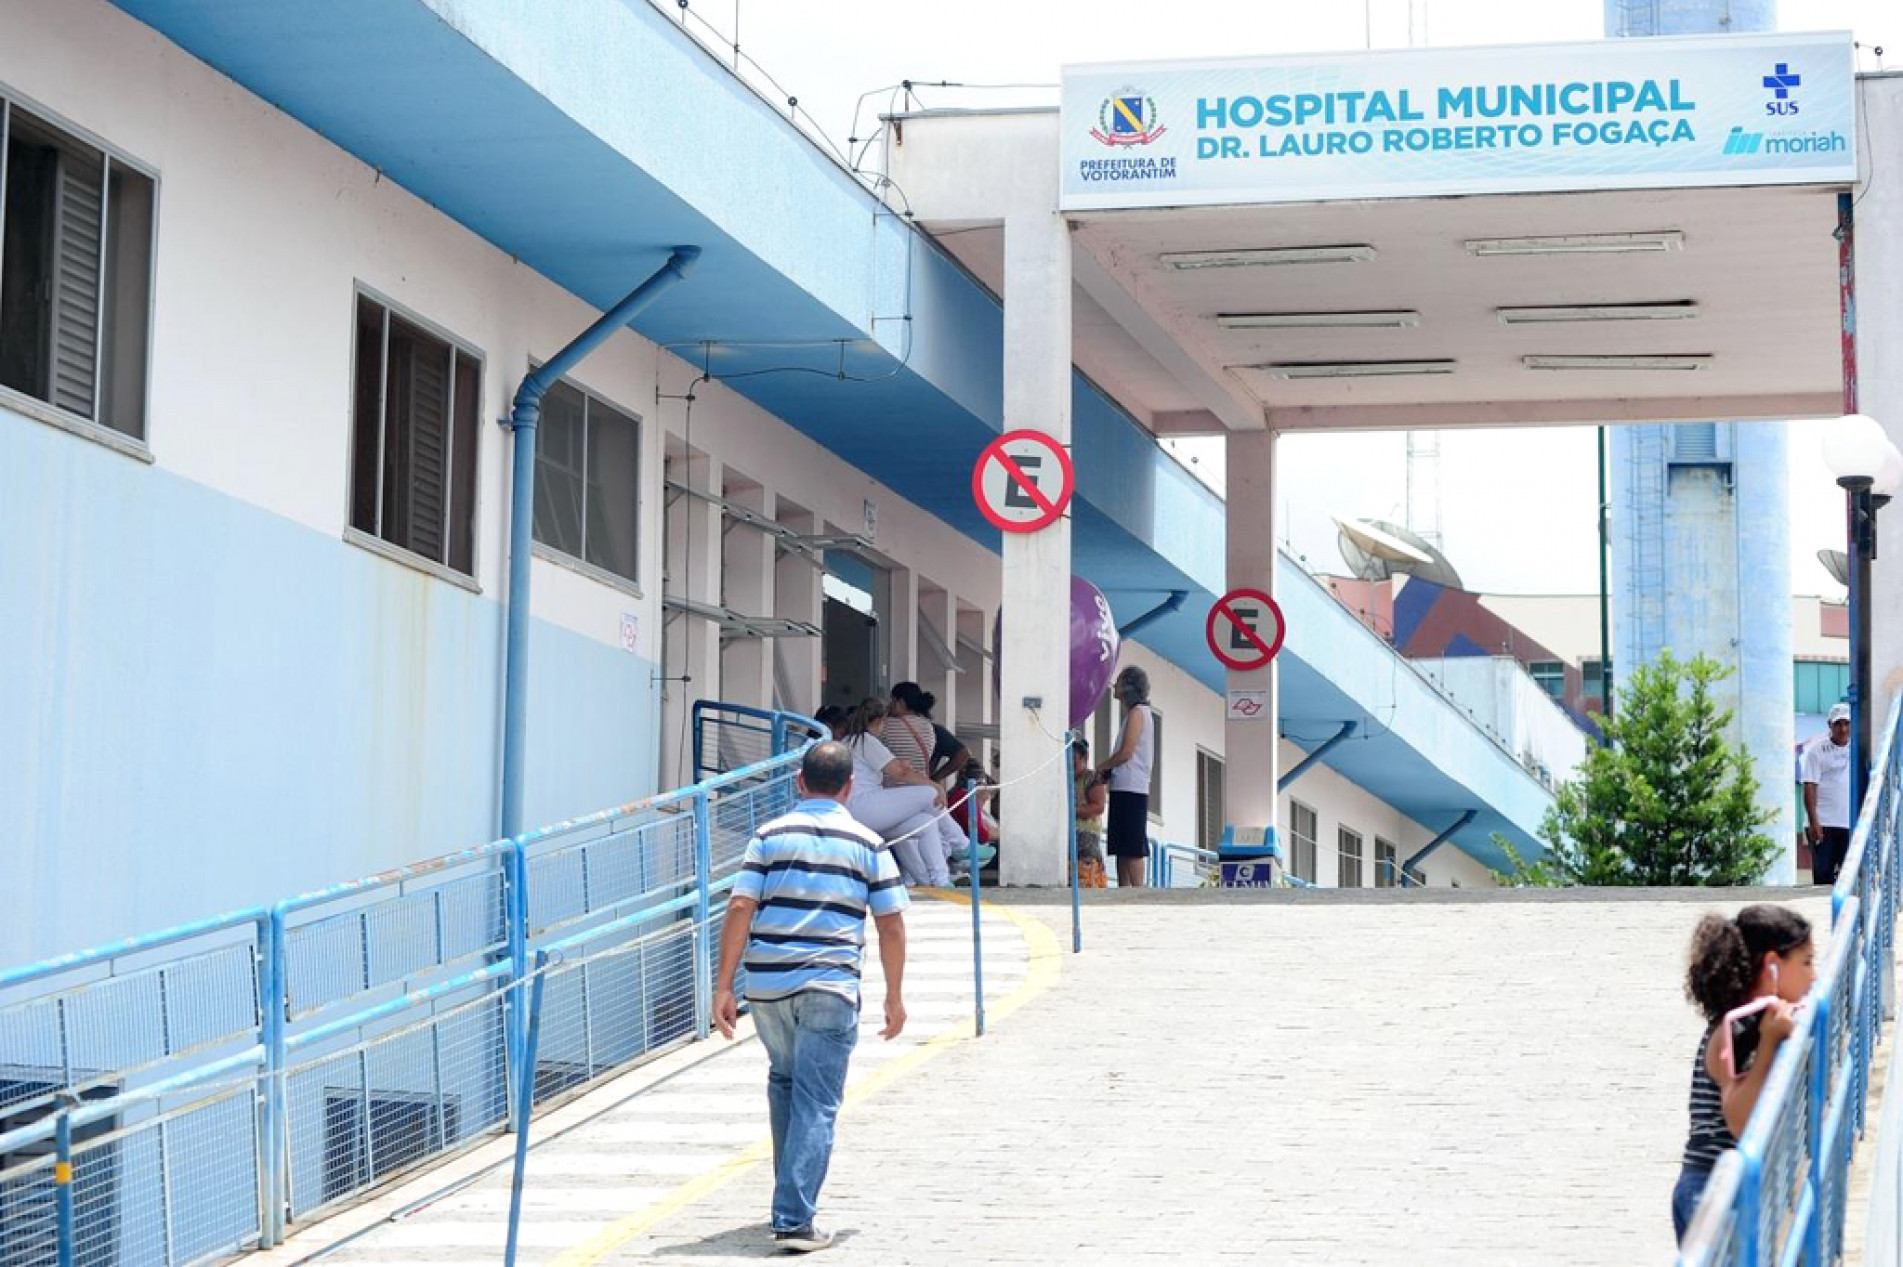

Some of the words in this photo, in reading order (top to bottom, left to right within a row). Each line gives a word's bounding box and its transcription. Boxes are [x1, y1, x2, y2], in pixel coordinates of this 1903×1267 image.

[1196, 88, 1425, 130] HOSPITAL
[1437, 79, 1696, 121] MUNICIPAL
[1765, 101, 1800, 116] SUS
[1196, 136, 1250, 160] DR.
[1259, 131, 1374, 157] LAURO
[1382, 124, 1543, 153] ROBERTO
[1552, 118, 1696, 148] FOGAÇA
[1765, 130, 1846, 153] moriah
[1079, 158, 1156, 171] PREFEITURA
[1160, 157, 1177, 169] DE
[1080, 169, 1177, 181] VOTORANTIM
